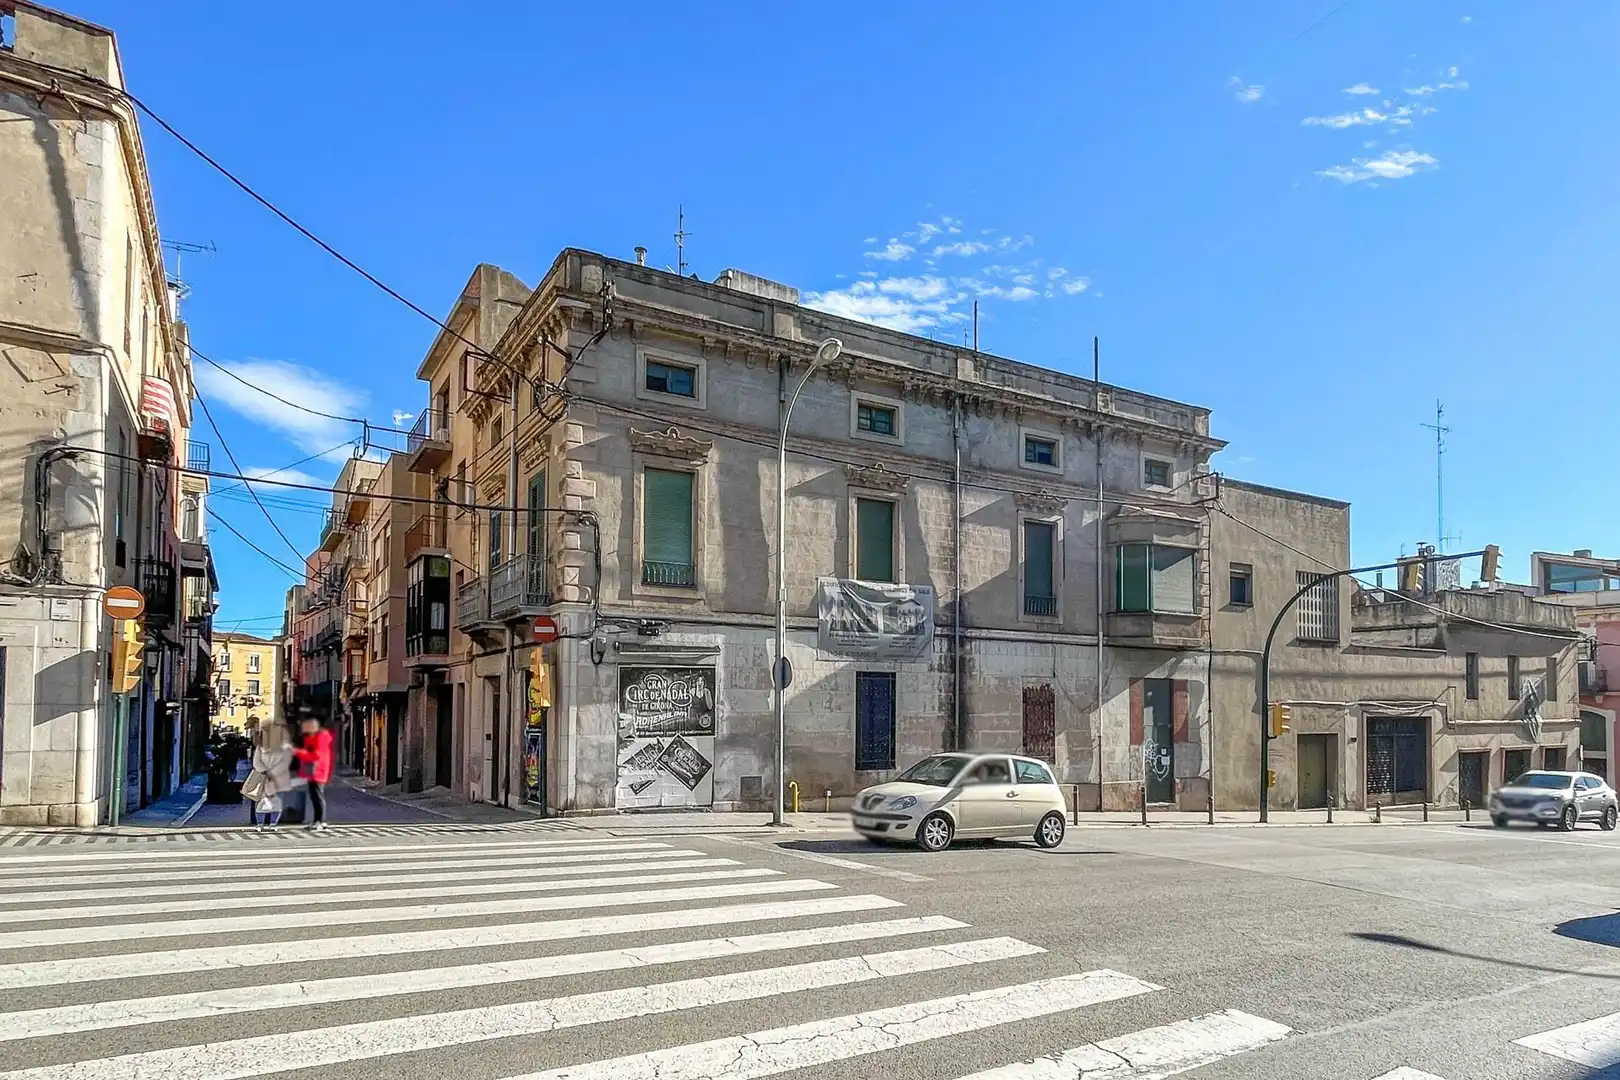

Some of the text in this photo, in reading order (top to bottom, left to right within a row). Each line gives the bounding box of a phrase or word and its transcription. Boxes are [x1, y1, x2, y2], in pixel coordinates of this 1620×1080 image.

[646, 678, 668, 690] GRAN
[626, 685, 650, 703] CIRC
[650, 691, 660, 700] DE
